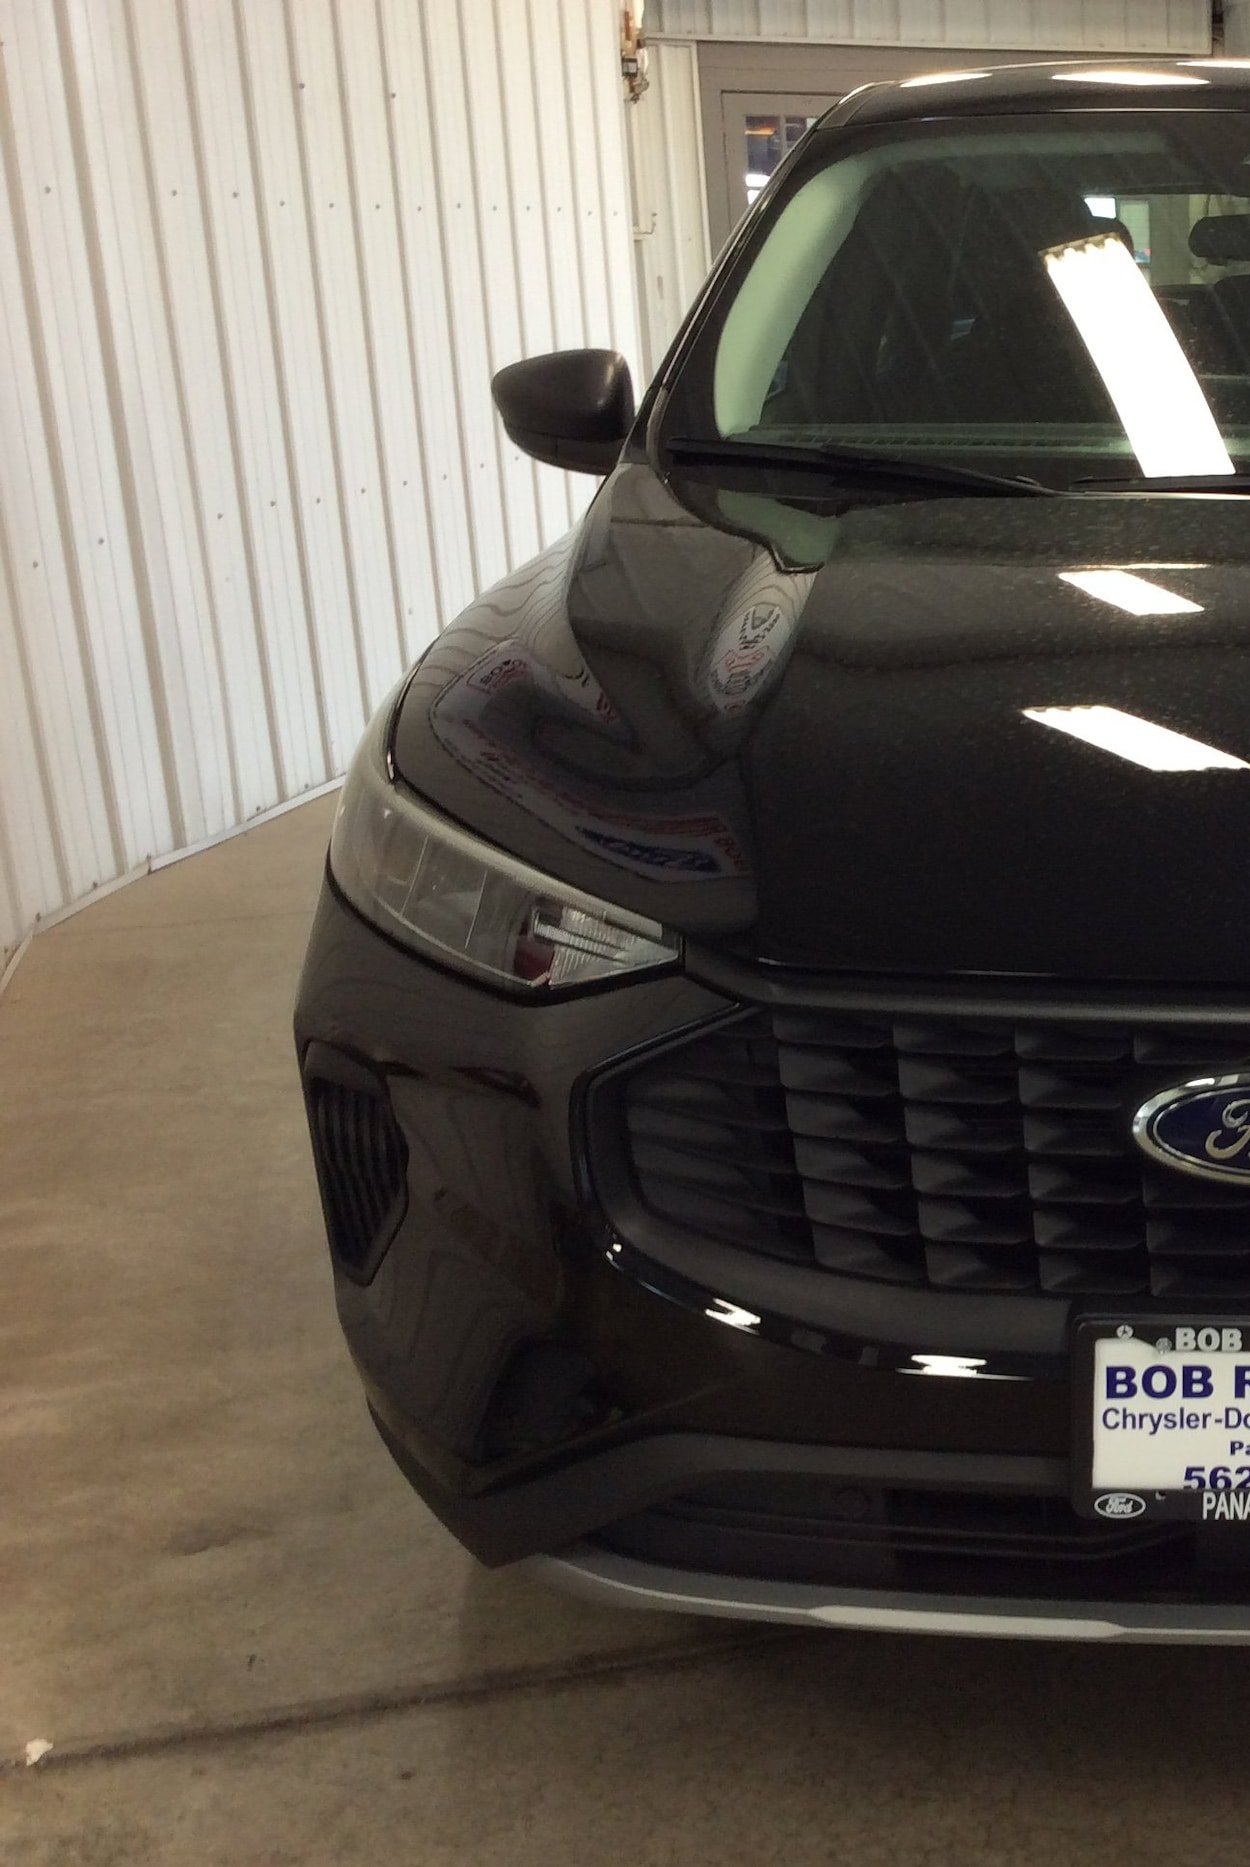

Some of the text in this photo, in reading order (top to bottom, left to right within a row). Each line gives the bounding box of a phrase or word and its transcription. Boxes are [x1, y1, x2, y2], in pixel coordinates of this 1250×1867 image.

[1175, 1327, 1243, 1352] BOB
[1105, 1364, 1214, 1400] BOB
[1105, 1496, 1134, 1514] Ford
